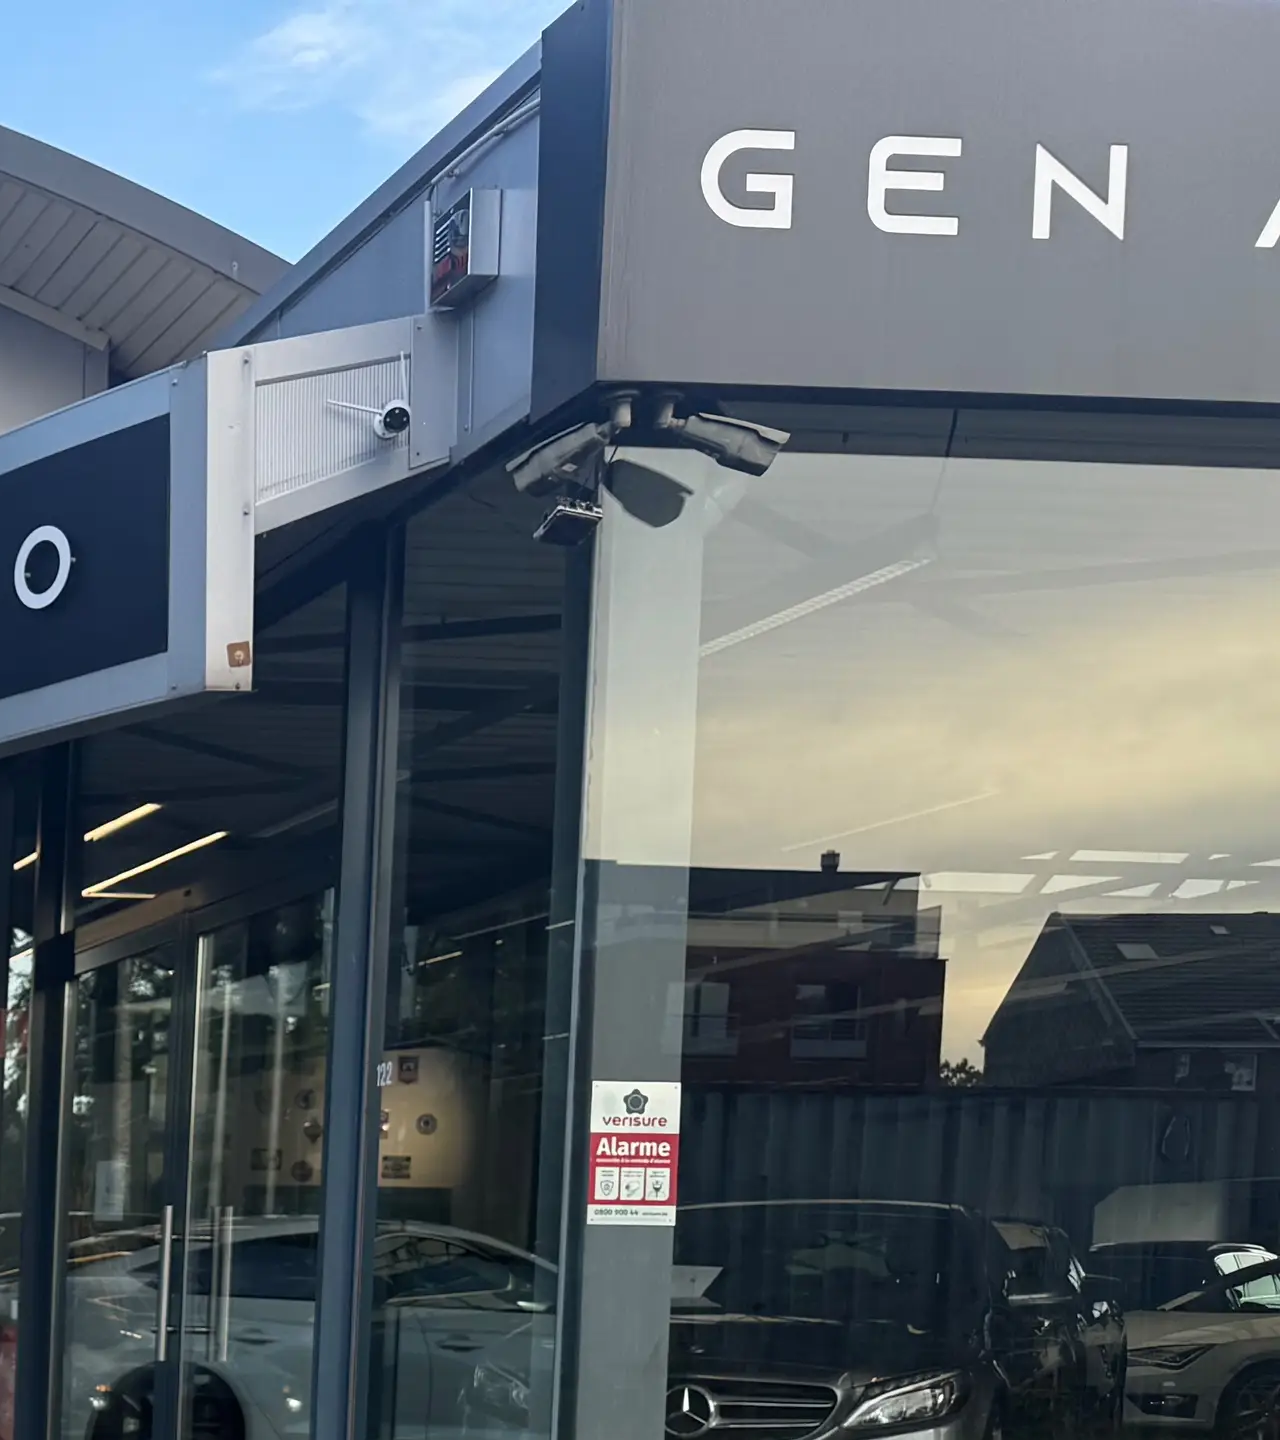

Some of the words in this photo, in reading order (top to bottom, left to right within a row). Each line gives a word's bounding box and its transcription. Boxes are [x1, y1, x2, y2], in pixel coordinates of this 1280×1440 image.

[700, 128, 1130, 241] GEN
[375, 1060, 393, 1087] 122
[601, 1114, 669, 1128] verisure
[595, 1136, 672, 1157] Alarme
